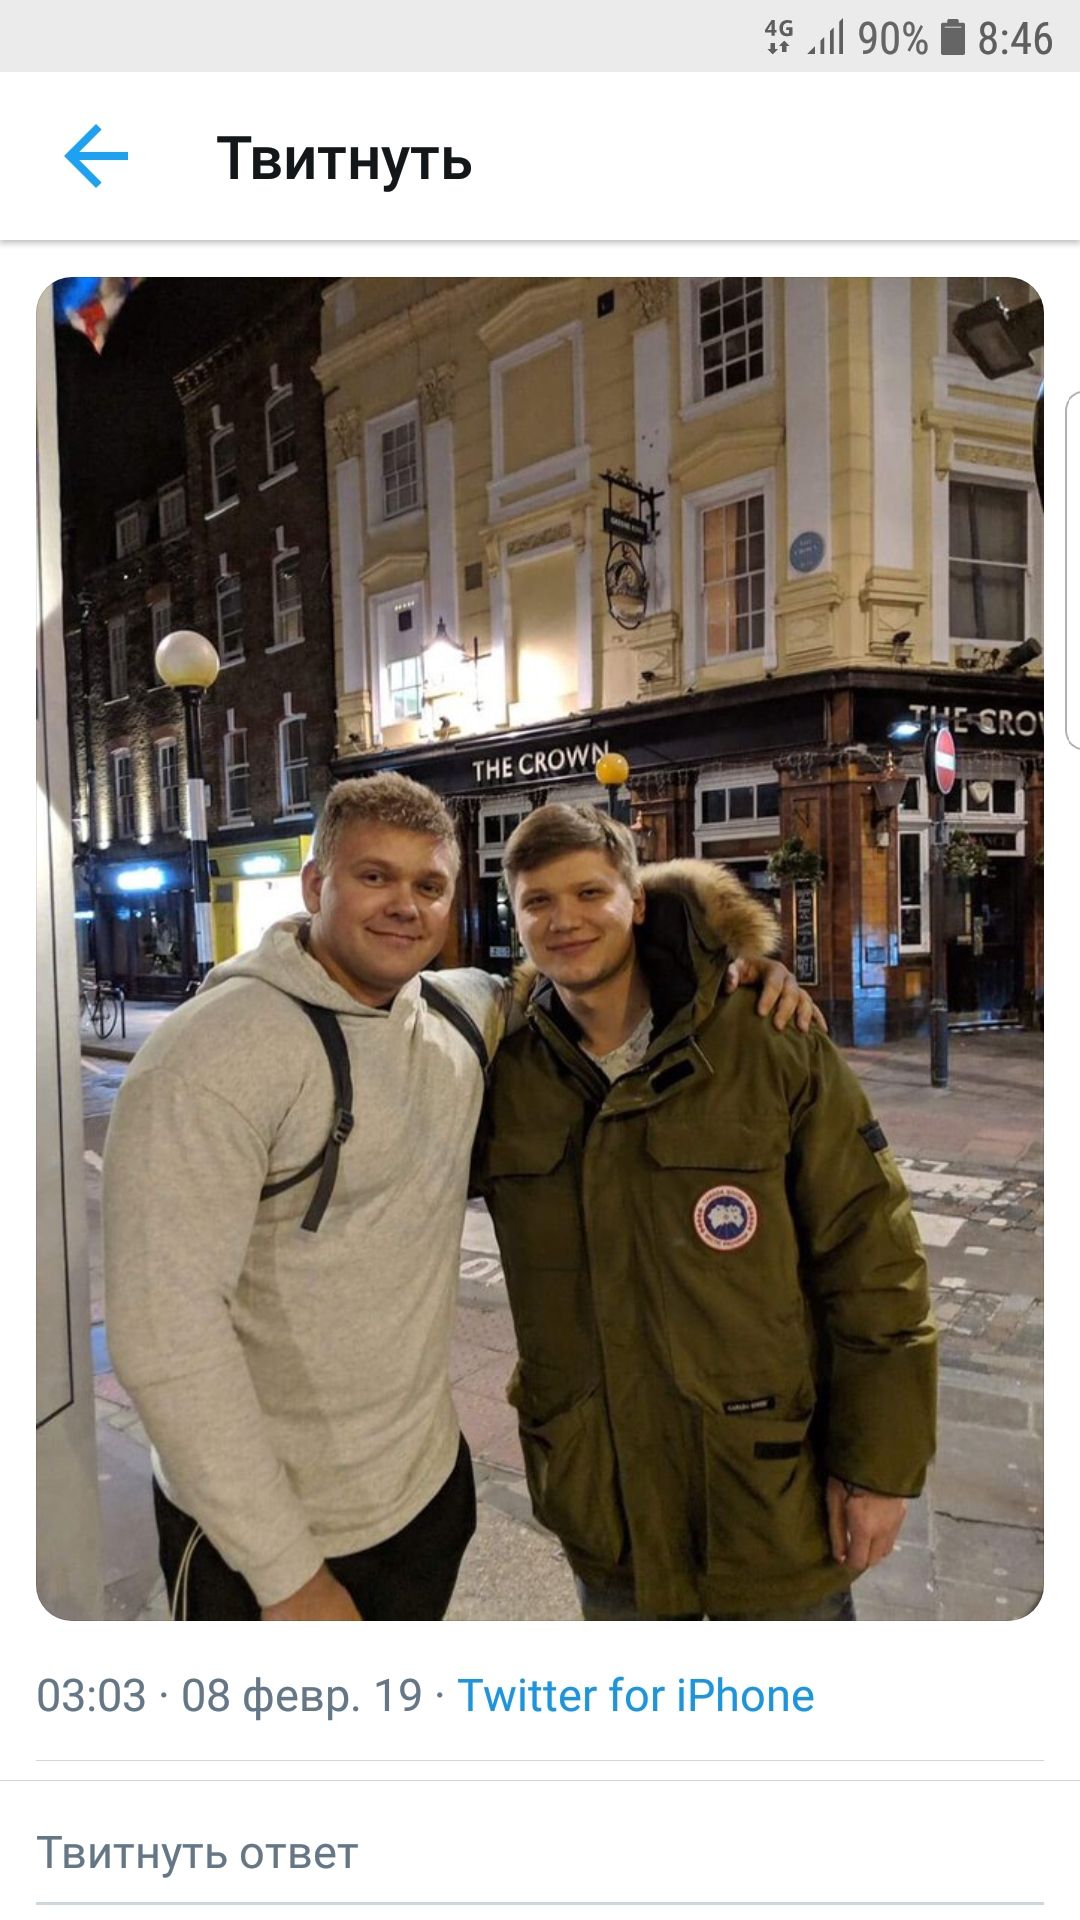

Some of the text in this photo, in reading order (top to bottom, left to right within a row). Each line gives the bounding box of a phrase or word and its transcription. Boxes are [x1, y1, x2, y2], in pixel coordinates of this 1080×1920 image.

[908, 704, 968, 734] THE
[472, 740, 609, 782] THE CROWN
